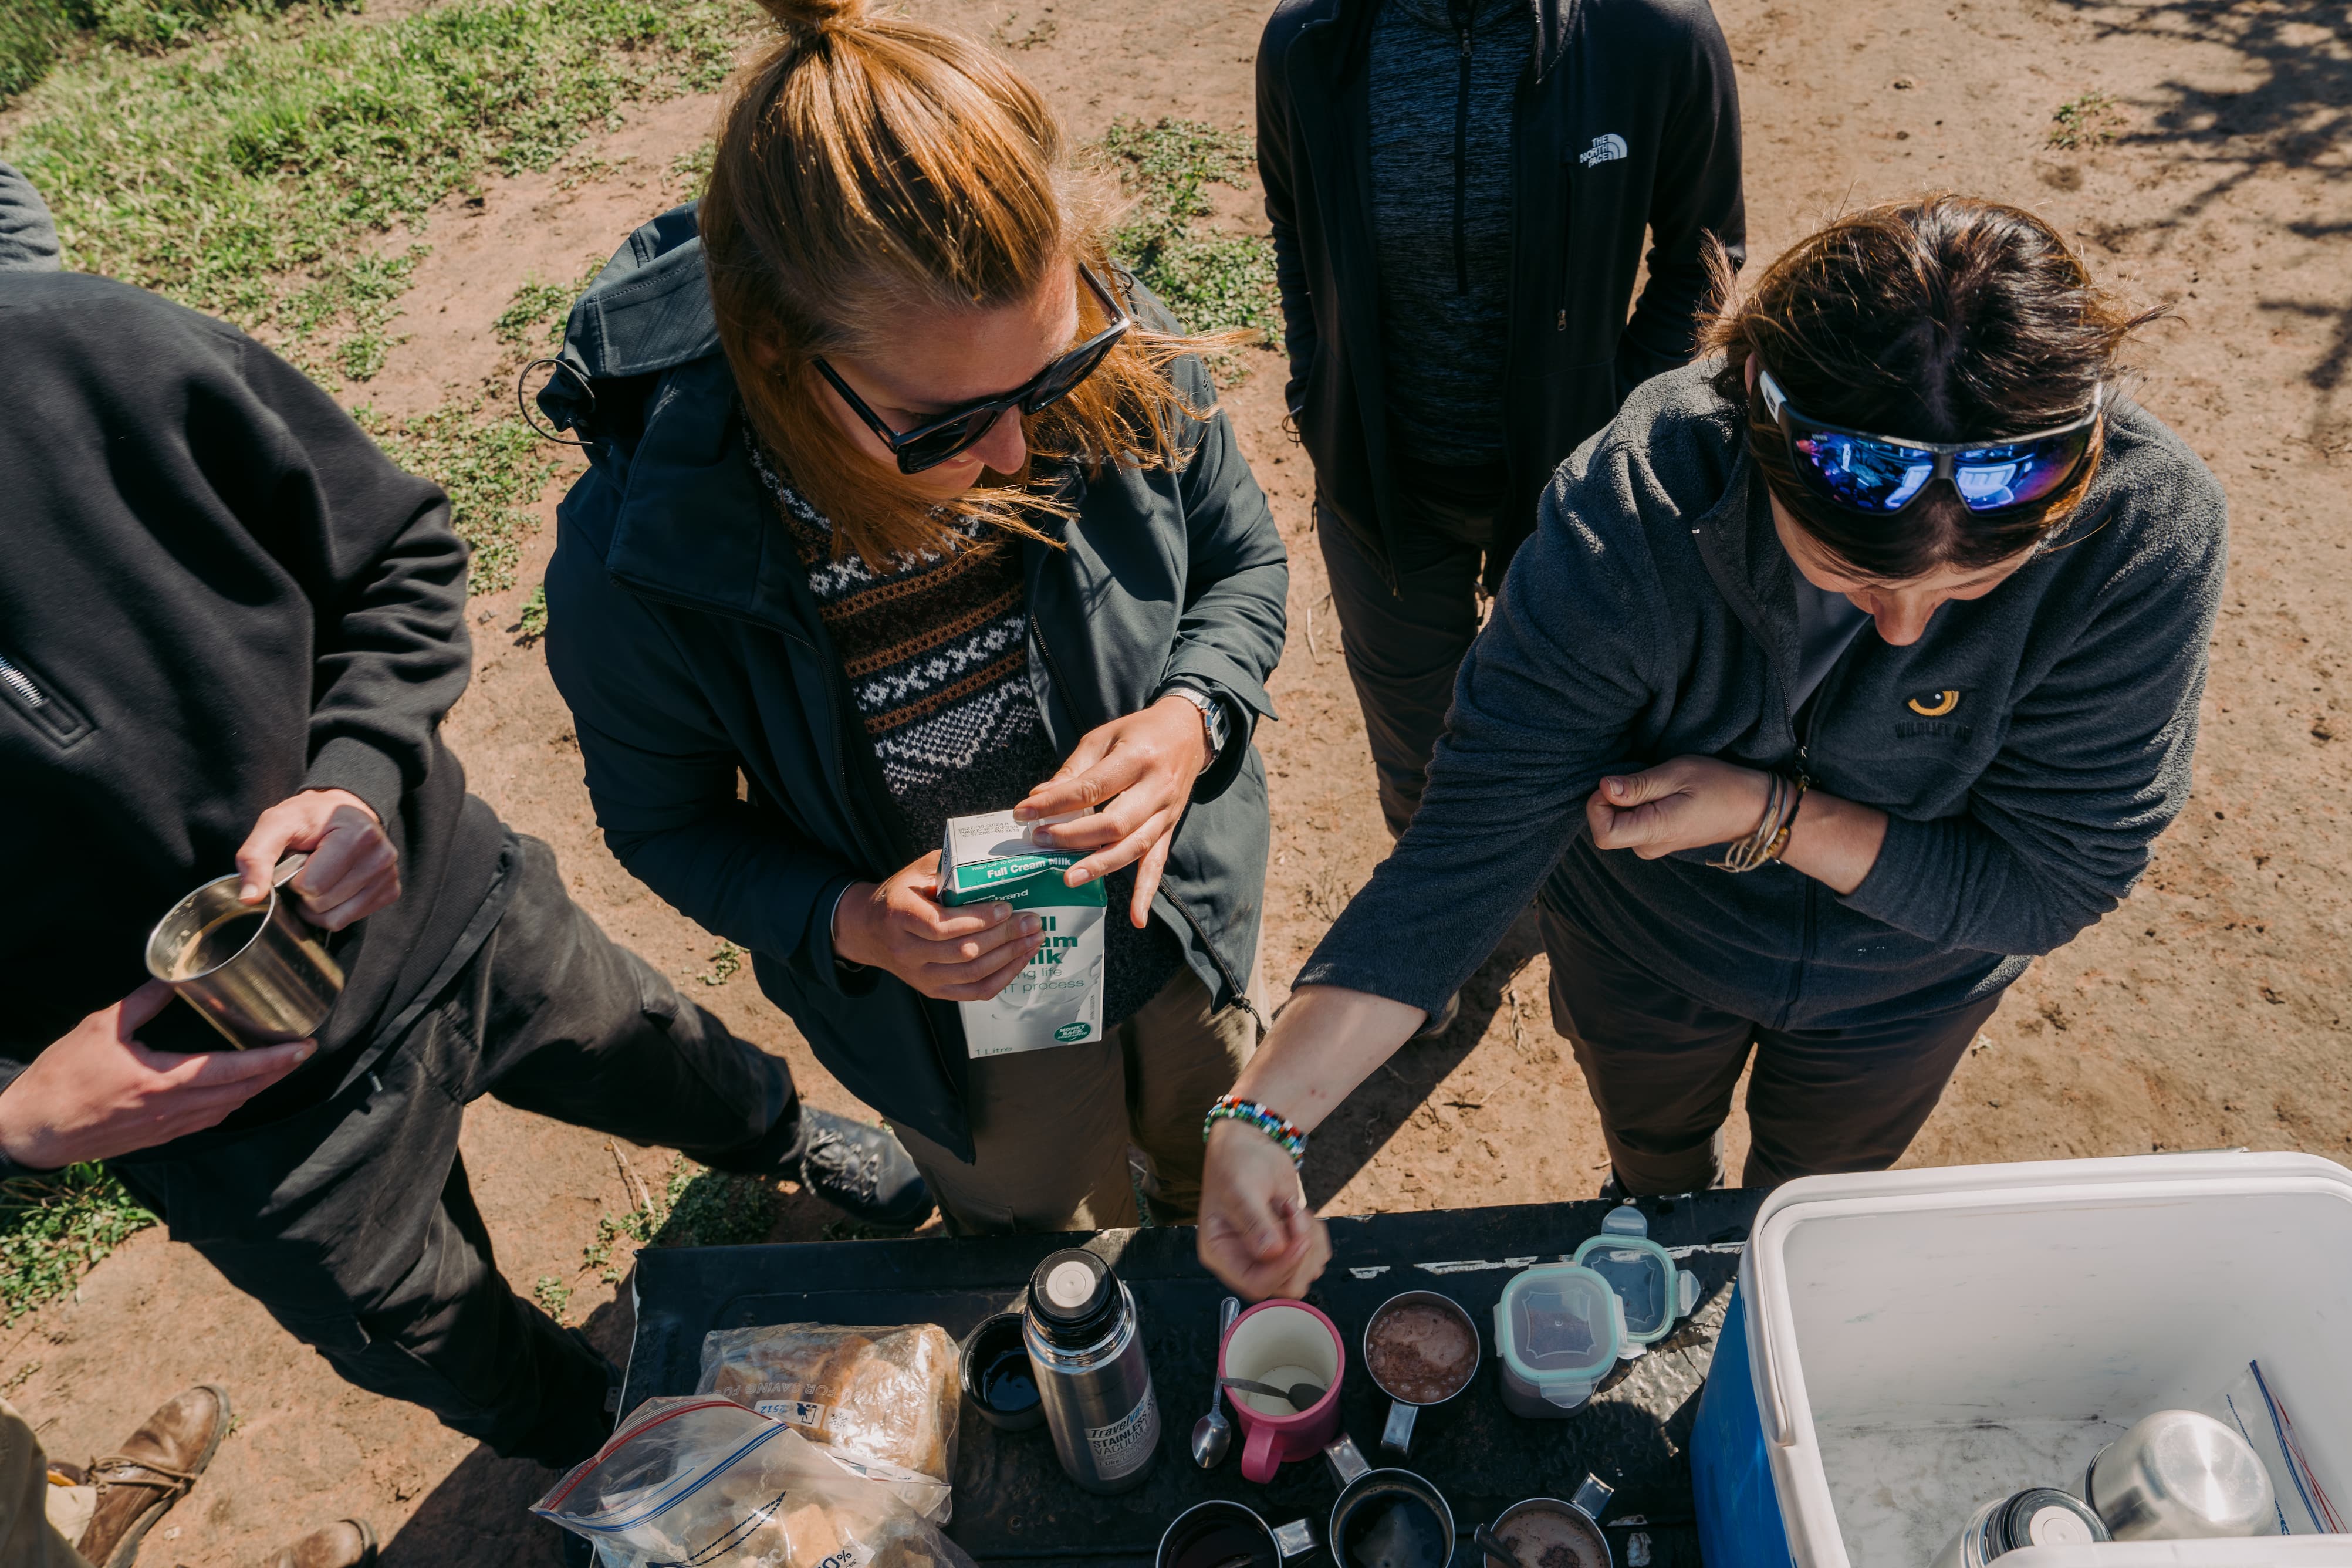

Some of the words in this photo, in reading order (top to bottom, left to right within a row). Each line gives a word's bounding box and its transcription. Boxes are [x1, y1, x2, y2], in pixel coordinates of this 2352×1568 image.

[1591, 134, 1608, 147] THE
[1579, 144, 1608, 163] NORTH
[1588, 153, 1610, 168] FACE
[987, 866, 1008, 878] Full
[1010, 860, 1046, 874] Cream
[1048, 857, 1072, 866] Milk
[1042, 968, 1062, 977] life
[1023, 979, 1084, 993] process
[1059, 1024, 1086, 1033] MONEY
[745, 1382, 800, 1396] SAVING
[805, 1384, 837, 1398] FOR
[1091, 1400, 1145, 1438] Travelvac
[1093, 1410, 1147, 1448] STAINLESS
[1094, 1427, 1144, 1455] VACUUM
